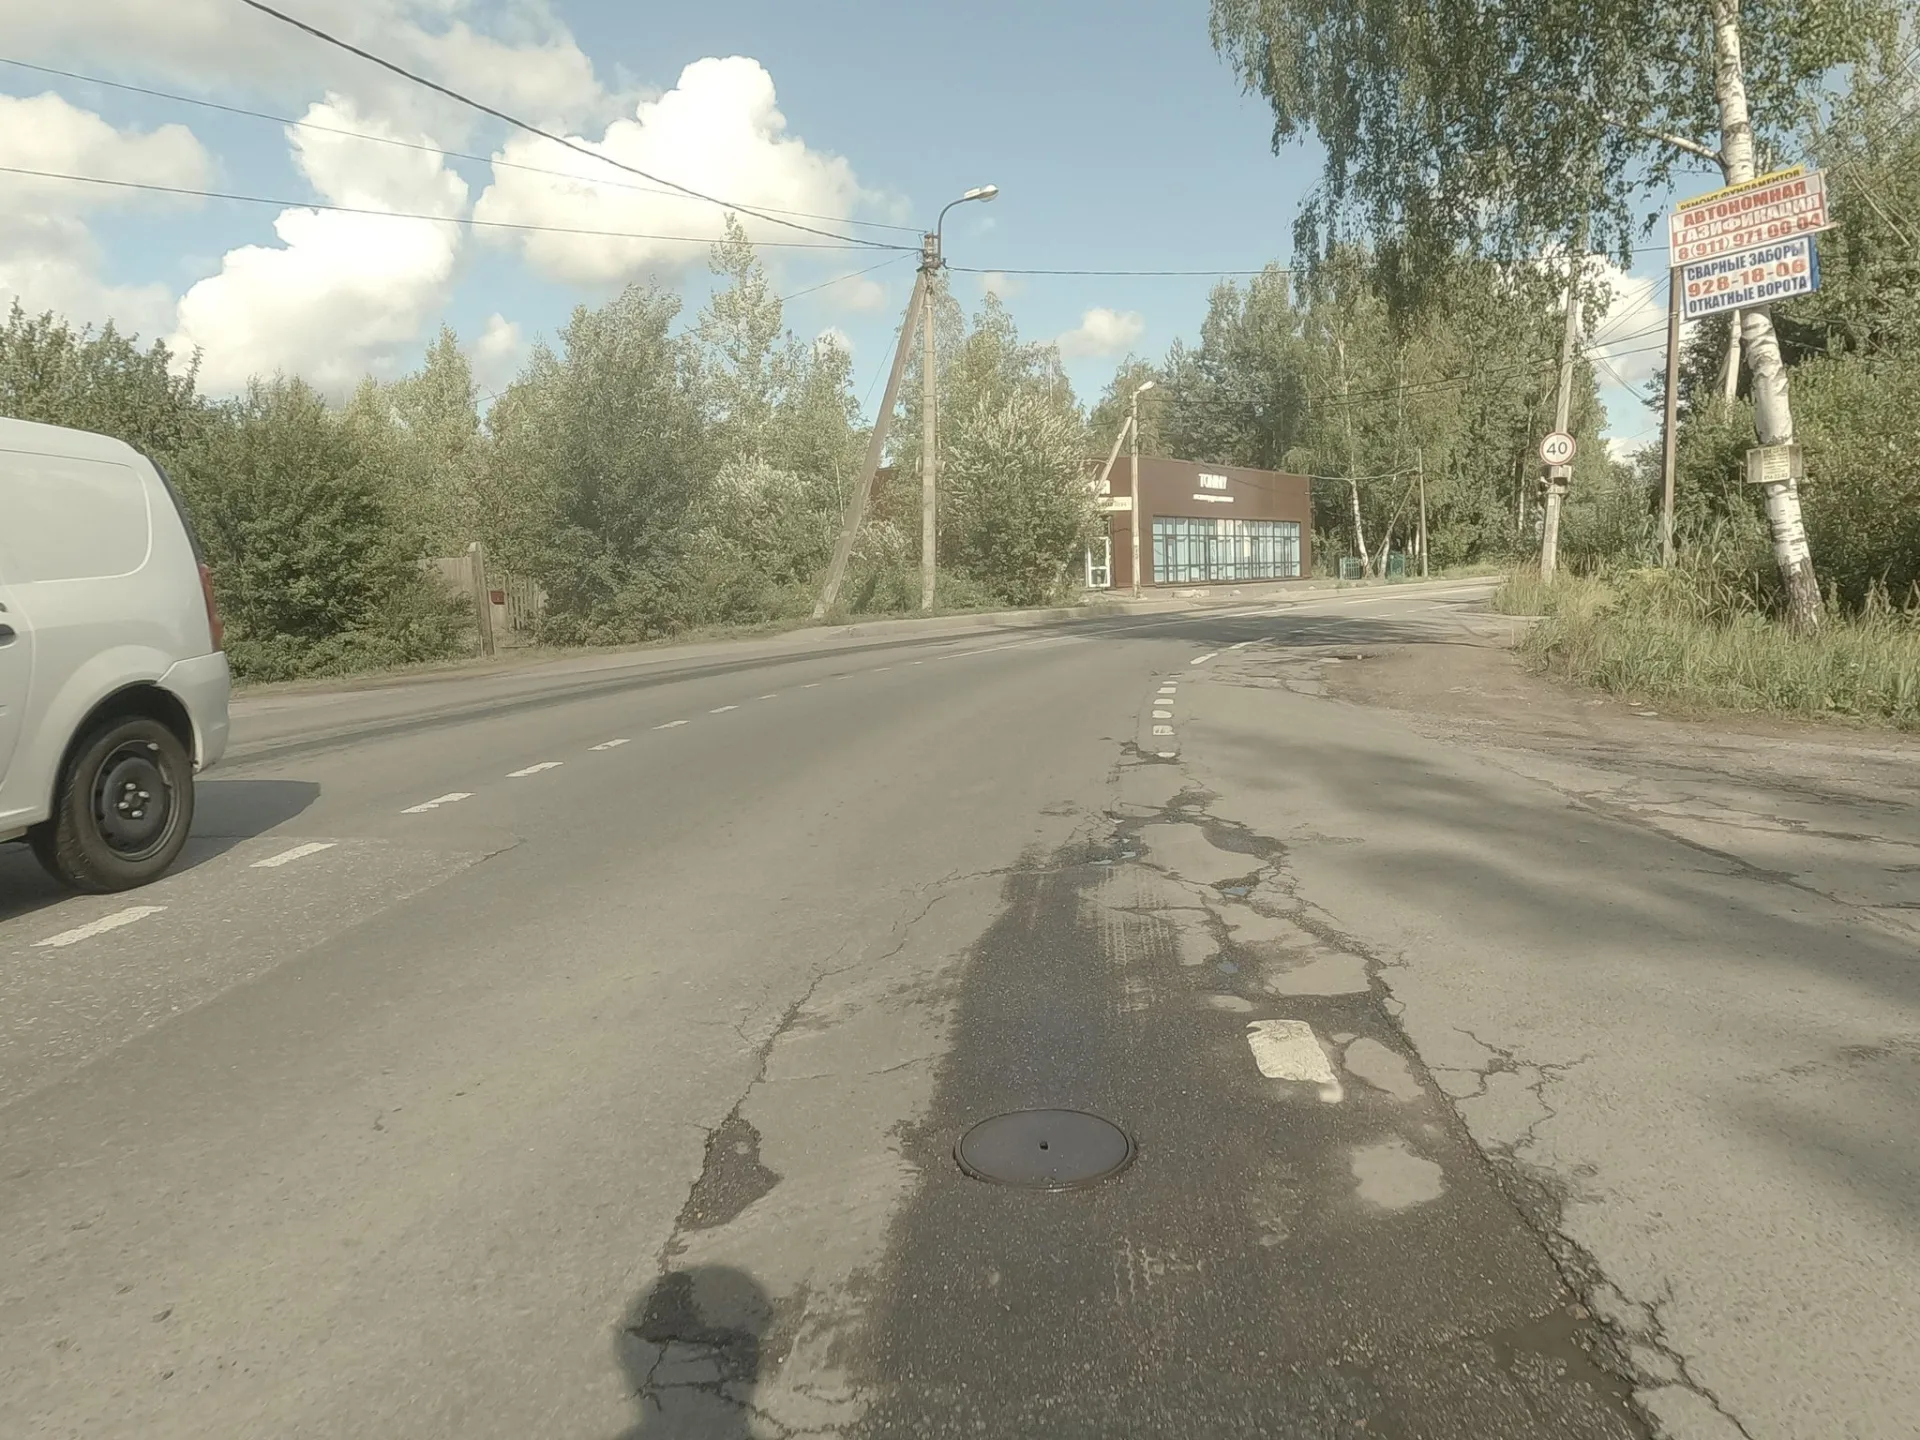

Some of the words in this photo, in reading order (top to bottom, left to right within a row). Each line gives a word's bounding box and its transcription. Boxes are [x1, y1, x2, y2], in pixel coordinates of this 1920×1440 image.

[1677, 194, 1820, 245] ГАЗИФИКАЦИЯ
[1684, 181, 1806, 228] АВТОНОМНАЯ
[1687, 255, 1747, 281] СВАРНЫЕ
[1748, 241, 1805, 267] ЗАБОРЫ
[1687, 259, 1807, 298] 928-18-06
[1689, 287, 1756, 314] ОТКАТНЫЕ
[1757, 275, 1808, 298] ВОРОТА
[1546, 441, 1568, 456] 40
